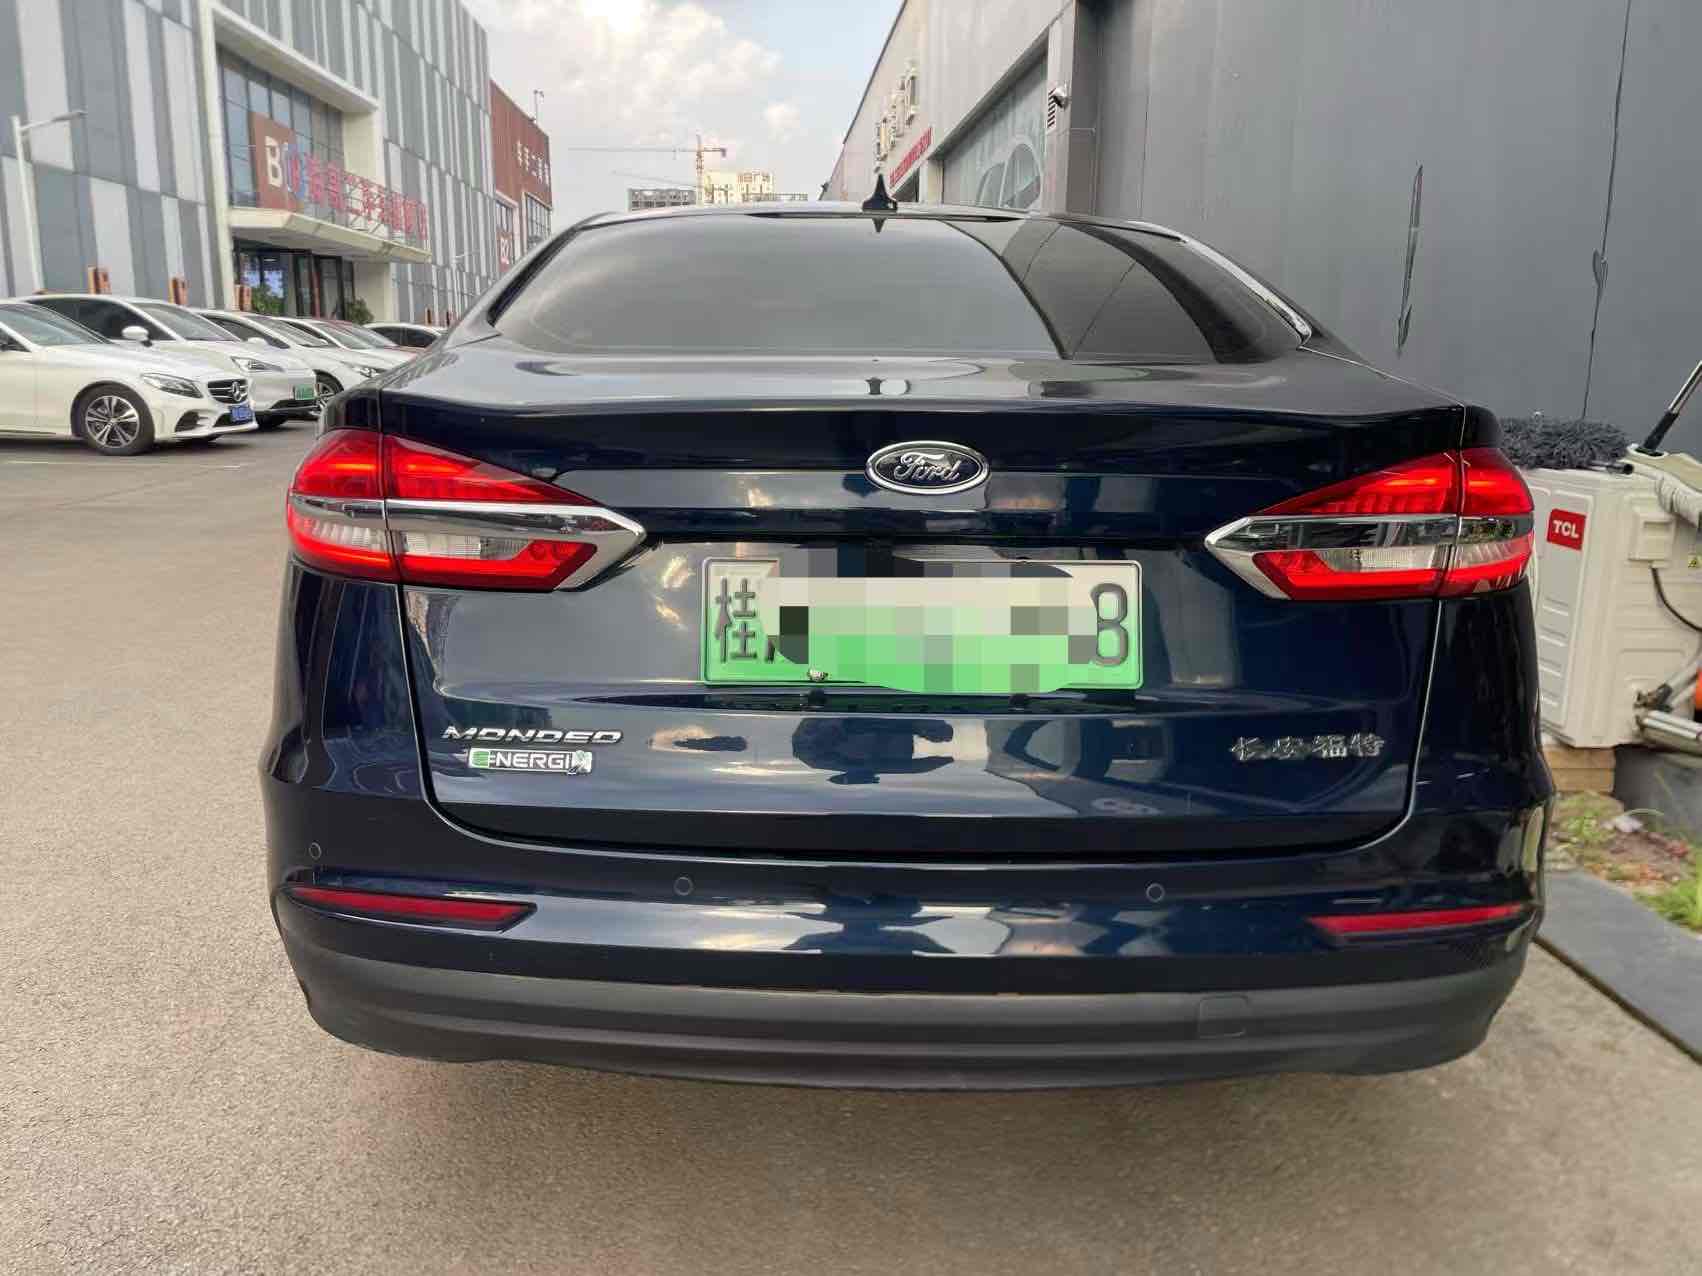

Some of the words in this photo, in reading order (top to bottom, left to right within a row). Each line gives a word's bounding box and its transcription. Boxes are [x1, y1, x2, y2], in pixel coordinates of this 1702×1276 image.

[893, 452, 962, 480] Ford
[1553, 520, 1580, 539] TCL
[443, 725, 623, 744] MONDEO
[1228, 732, 1385, 761] 长安福特
